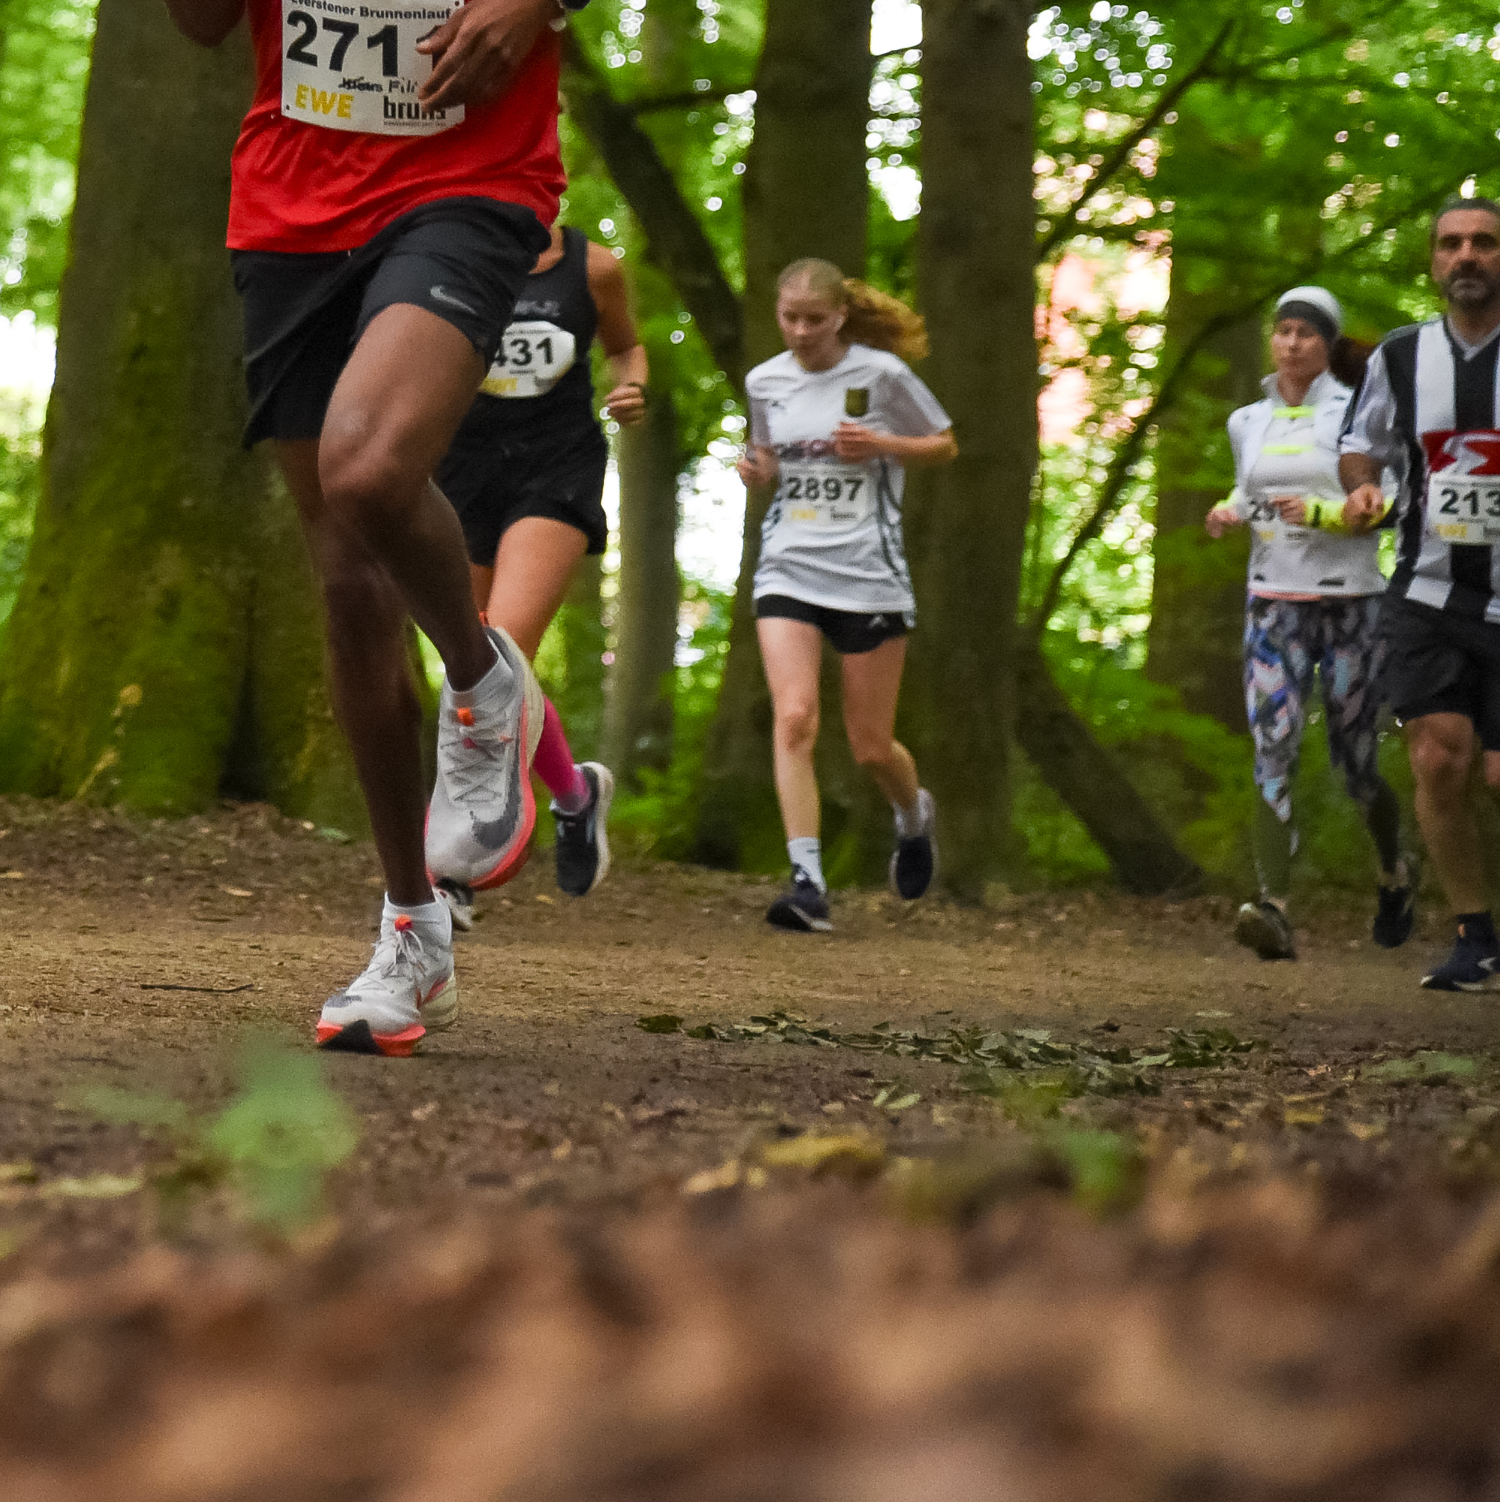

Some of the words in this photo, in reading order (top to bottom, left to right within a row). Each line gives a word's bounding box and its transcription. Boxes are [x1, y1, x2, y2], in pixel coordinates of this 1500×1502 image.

[359, 5, 452, 20] Brunnenlauf
[285, 9, 443, 78] 271
[294, 83, 355, 120] EWE
[786, 477, 863, 502] 2897
